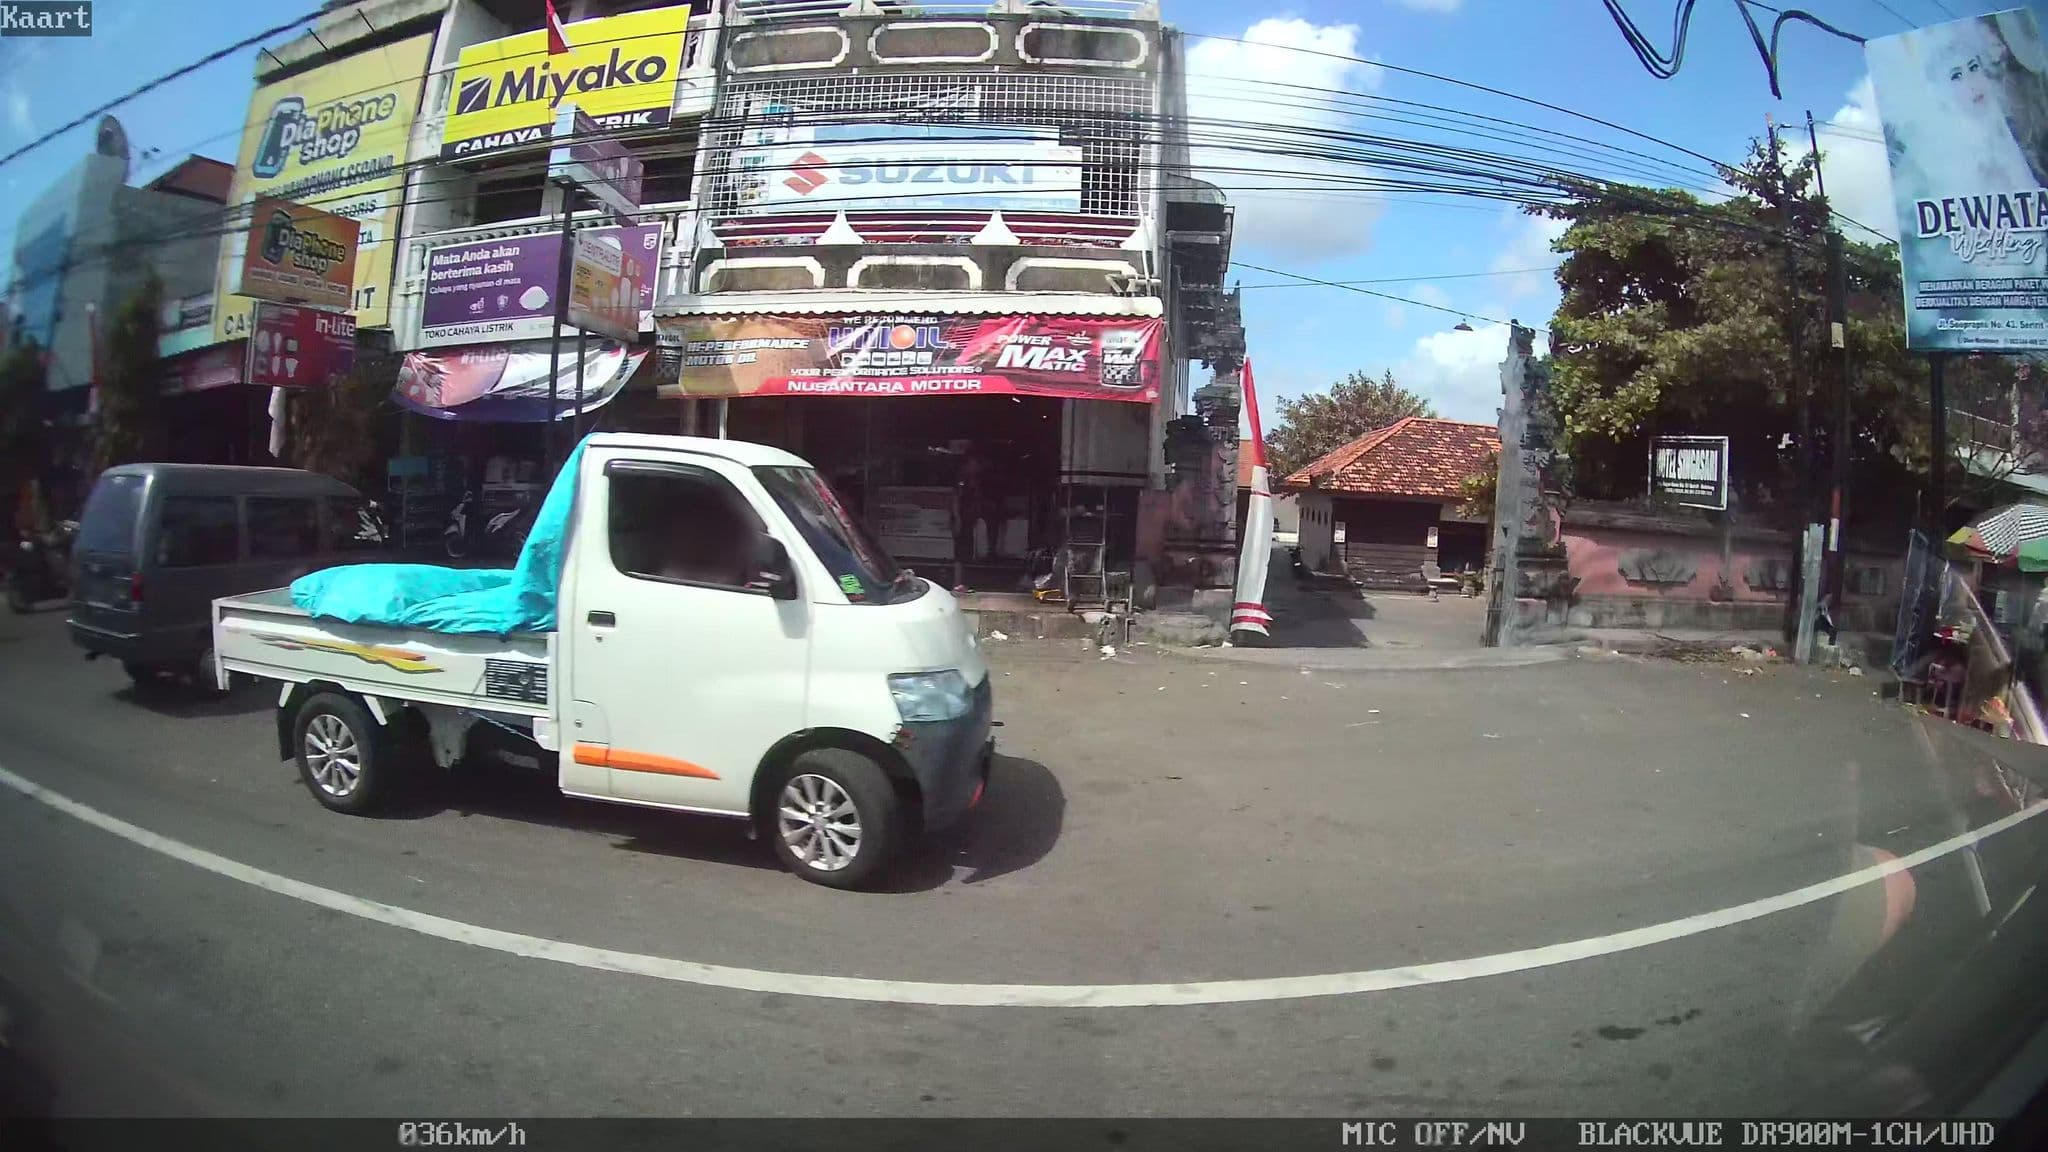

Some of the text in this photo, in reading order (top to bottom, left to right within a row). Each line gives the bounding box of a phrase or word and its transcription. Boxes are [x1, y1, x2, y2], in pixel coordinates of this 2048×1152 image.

[494, 48, 668, 108] Miyako
[455, 111, 653, 154] CAHAYA TRIK
[299, 128, 360, 165] shop
[838, 155, 1035, 185] SUZUKI
[1917, 190, 2048, 235] DEWATA
[433, 244, 520, 266] Mata Anda akan
[1950, 229, 2042, 264] Wedding
[292, 251, 328, 275] shop
[431, 260, 514, 281] berterima kasih
[495, 278, 503, 286] di
[503, 277, 521, 286] mata
[315, 312, 356, 337] in-lite
[425, 329, 446, 339] TOKO
[447, 326, 480, 337] CAHAYA
[481, 322, 514, 334] LISTRIK
[828, 324, 950, 350] UNIOIL
[996, 334, 1052, 346] POWER
[685, 351, 758, 366] MOTOR OIL
[995, 345, 1091, 369] MAX
[791, 368, 821, 378] YOUR
[823, 367, 908, 377] PERFORMANCE
[788, 379, 982, 393] NUSANTARA MOTOR
